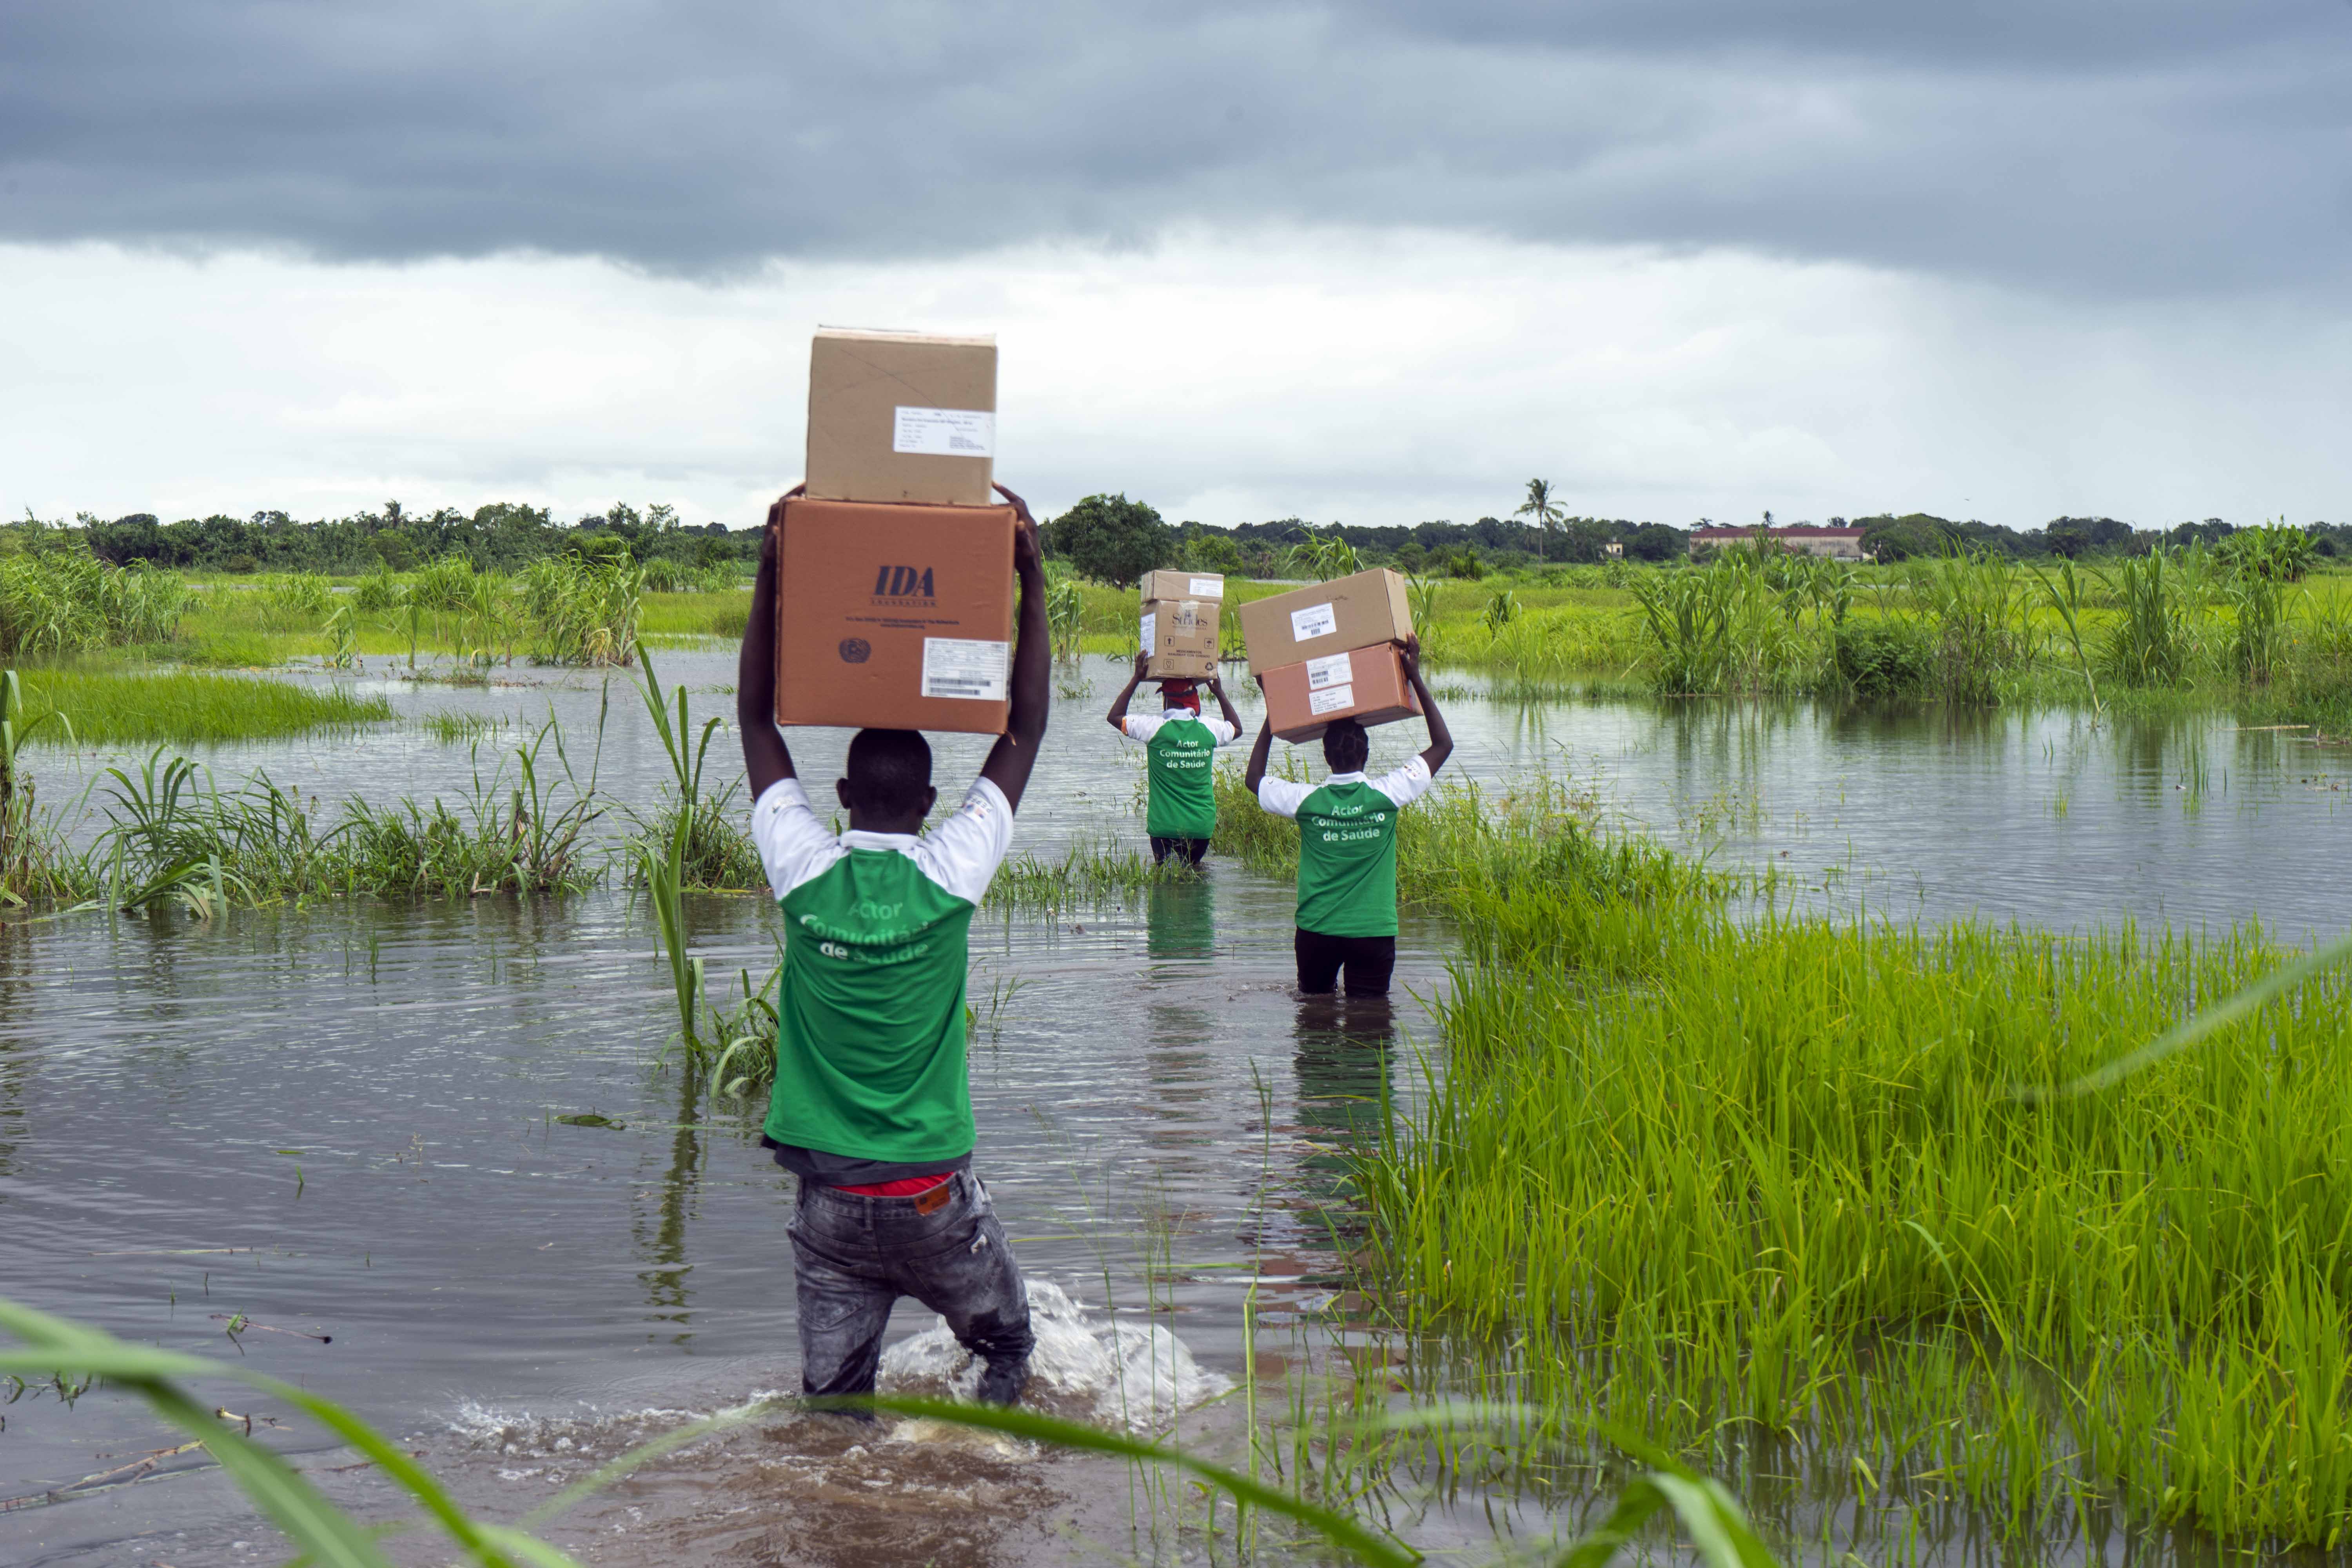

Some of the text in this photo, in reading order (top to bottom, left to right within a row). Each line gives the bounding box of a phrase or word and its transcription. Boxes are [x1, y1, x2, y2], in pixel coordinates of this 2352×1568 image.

[873, 566, 935, 597] IDA
[1176, 740, 1199, 748] Actor
[1160, 748, 1210, 758] Comunitário
[1166, 760, 1205, 769] de Saúde
[1331, 804, 1363, 816] Actor
[1311, 812, 1385, 827] Comunitário
[1323, 828, 1380, 841] de Saúde
[820, 941, 848, 960] de
